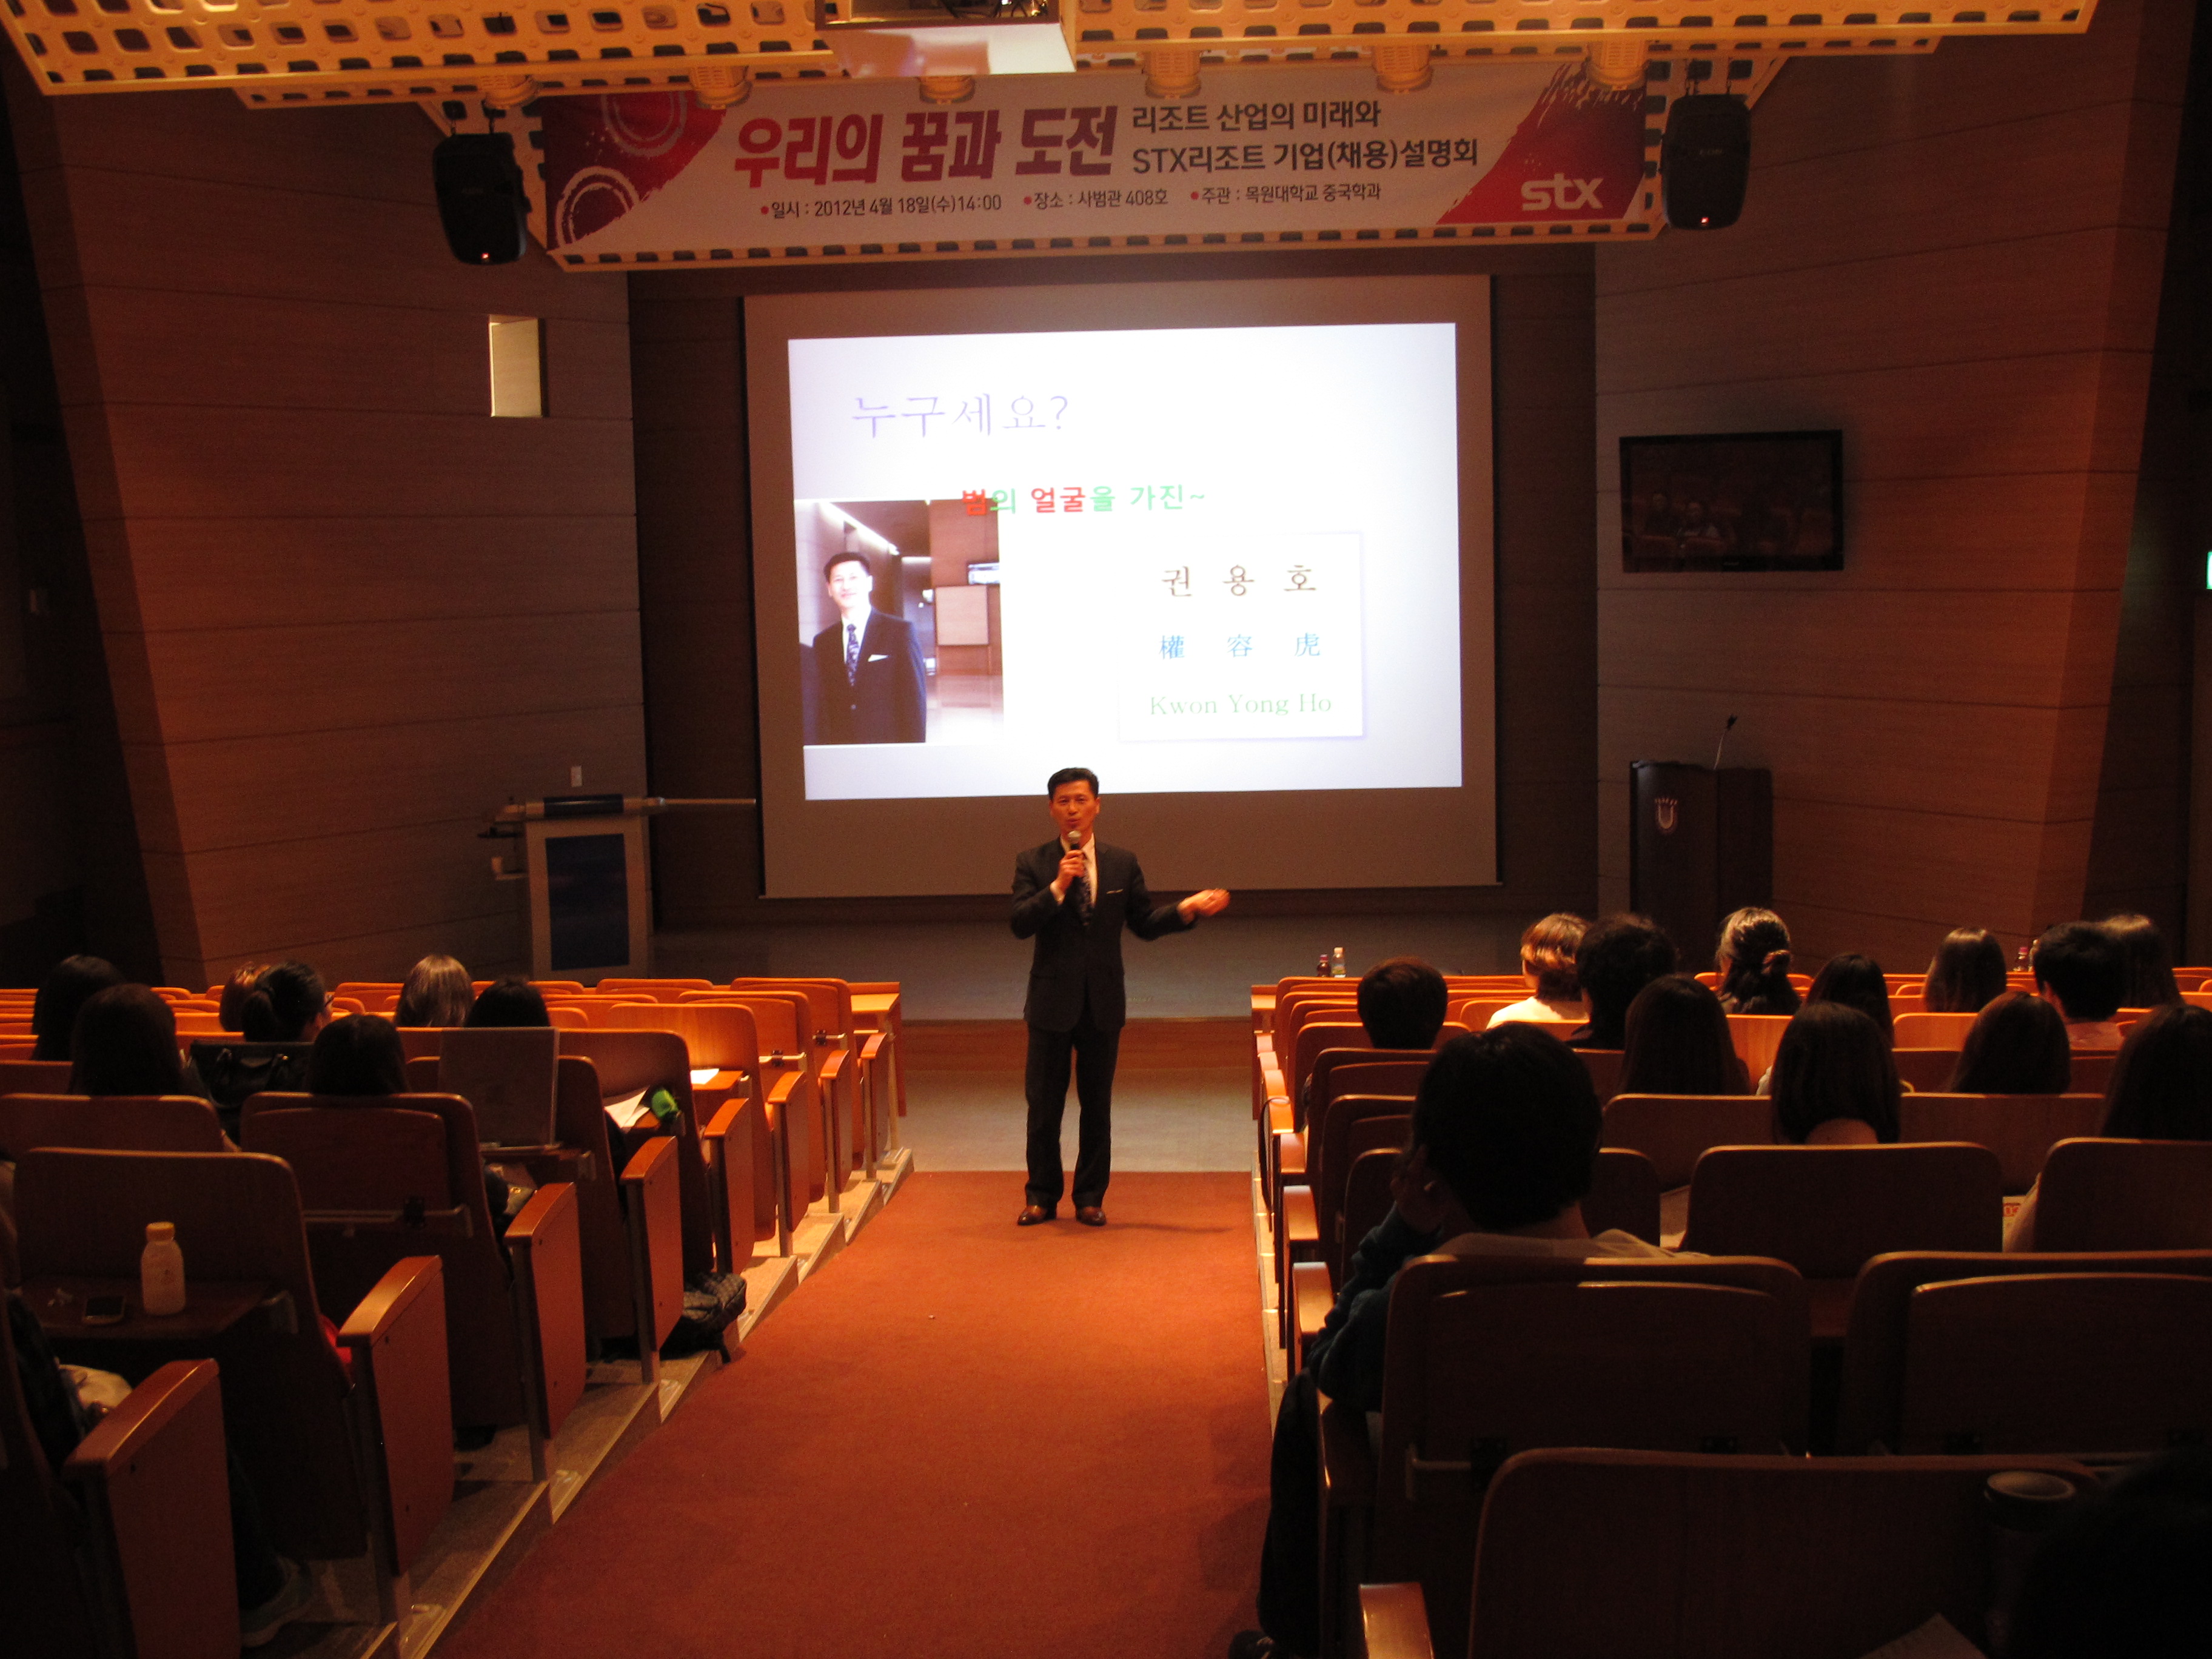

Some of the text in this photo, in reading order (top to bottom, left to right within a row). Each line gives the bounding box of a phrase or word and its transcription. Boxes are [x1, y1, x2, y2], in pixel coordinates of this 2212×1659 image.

[1133, 99, 1381, 132] 리조트 산업의 미래와
[734, 105, 1117, 188] 우리의 꿈과 도전
[1133, 144, 1266, 174] STX리조트
[1034, 191, 1062, 210] 장소
[1078, 189, 1122, 208] 사범관
[1125, 189, 1168, 206] 408호
[1202, 187, 1230, 204] 주관
[1245, 184, 1318, 203] 목원대학교
[1323, 183, 1381, 202] 중국학과
[1521, 172, 1604, 212] stx
[772, 201, 799, 219] 일시
[814, 198, 866, 217] 2012년
[870, 197, 893, 215] 4월
[851, 393, 1069, 438] 누구세요?
[1030, 485, 1116, 514] 얼굴을
[1162, 565, 1316, 597] 권 용 호
[1227, 634, 1253, 658] 容
[1294, 632, 1321, 657] 虎
[1150, 693, 1332, 716] Kwon Yong Ho
